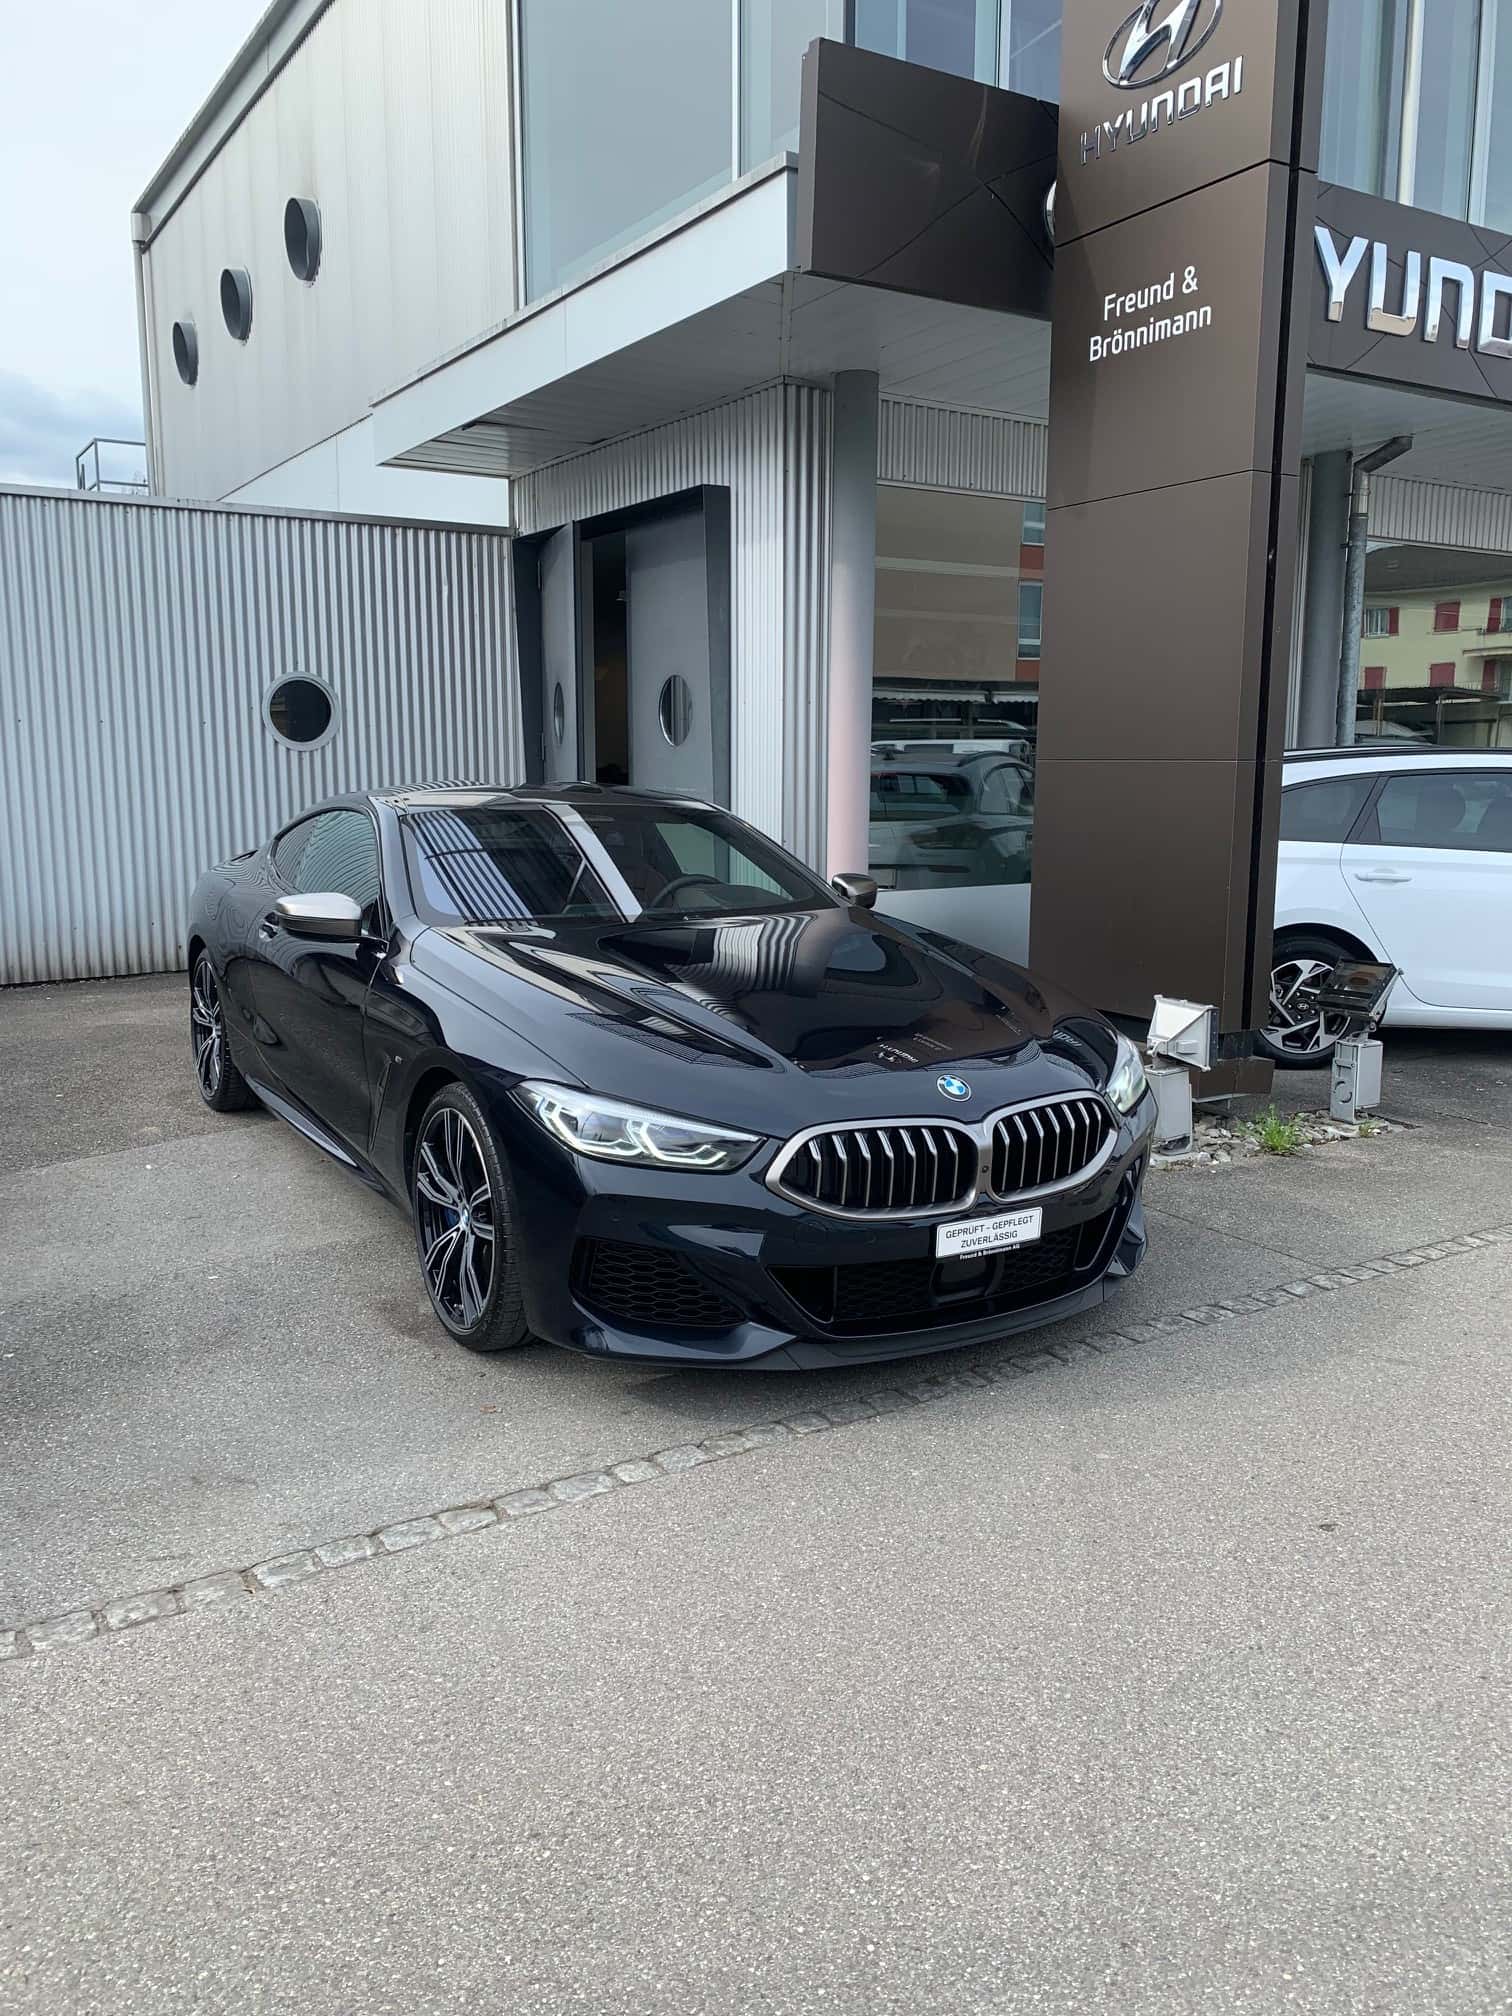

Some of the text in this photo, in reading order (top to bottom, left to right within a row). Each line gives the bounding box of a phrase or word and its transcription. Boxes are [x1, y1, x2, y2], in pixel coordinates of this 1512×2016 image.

[1080, 55, 1244, 166] HYUNDAI
[1104, 265, 1199, 321] Freund &
[1089, 305, 1212, 362] Brönnimann
[992, 1215, 1034, 1231] GEPFLEGT
